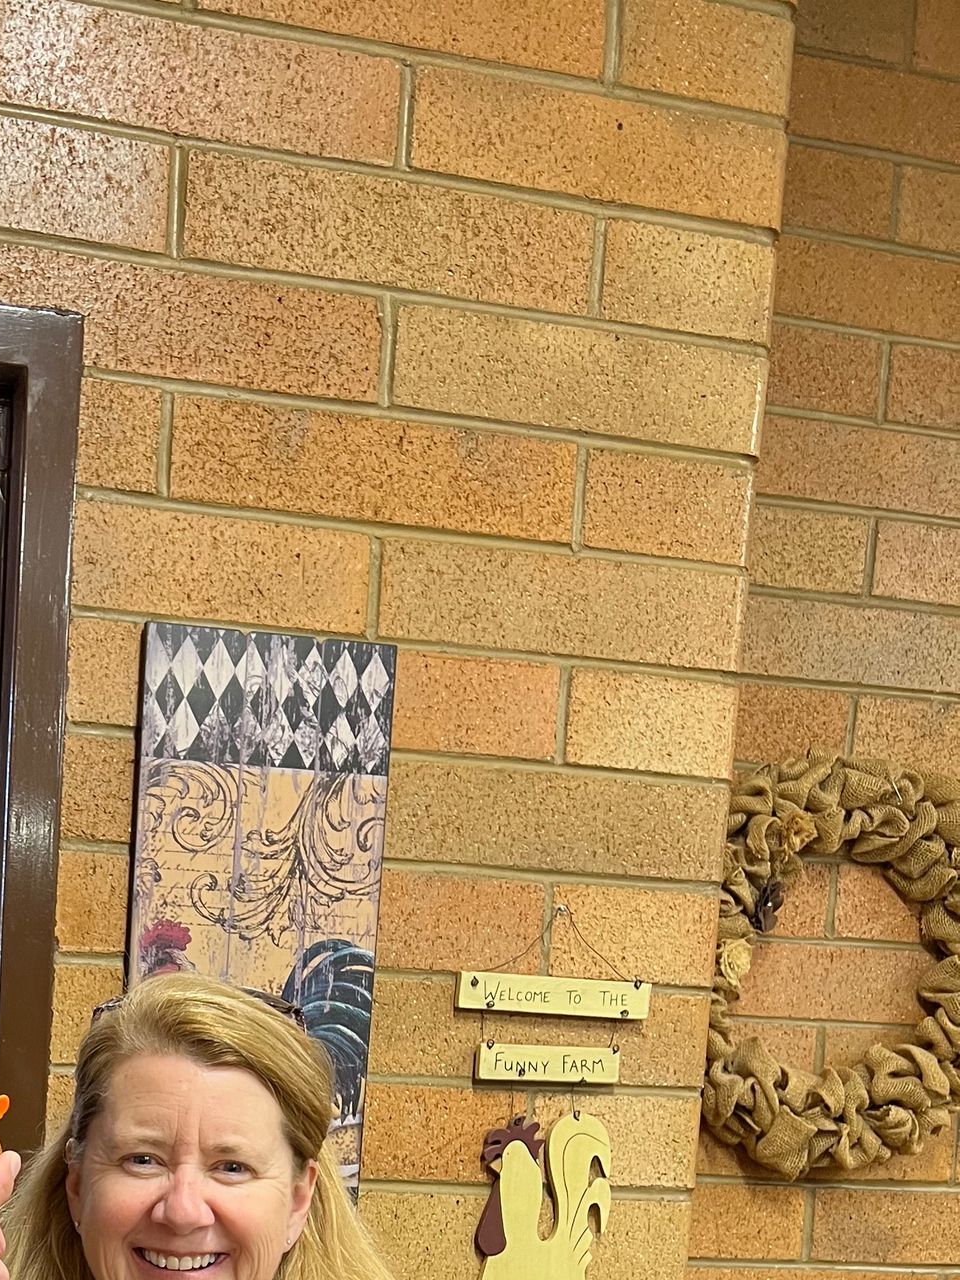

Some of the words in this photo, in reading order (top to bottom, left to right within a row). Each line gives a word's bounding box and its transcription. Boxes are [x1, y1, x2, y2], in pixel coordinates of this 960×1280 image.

[599, 990, 628, 1007] THE
[494, 1051, 550, 1076] FUNNY
[562, 1054, 605, 1075] FARM
